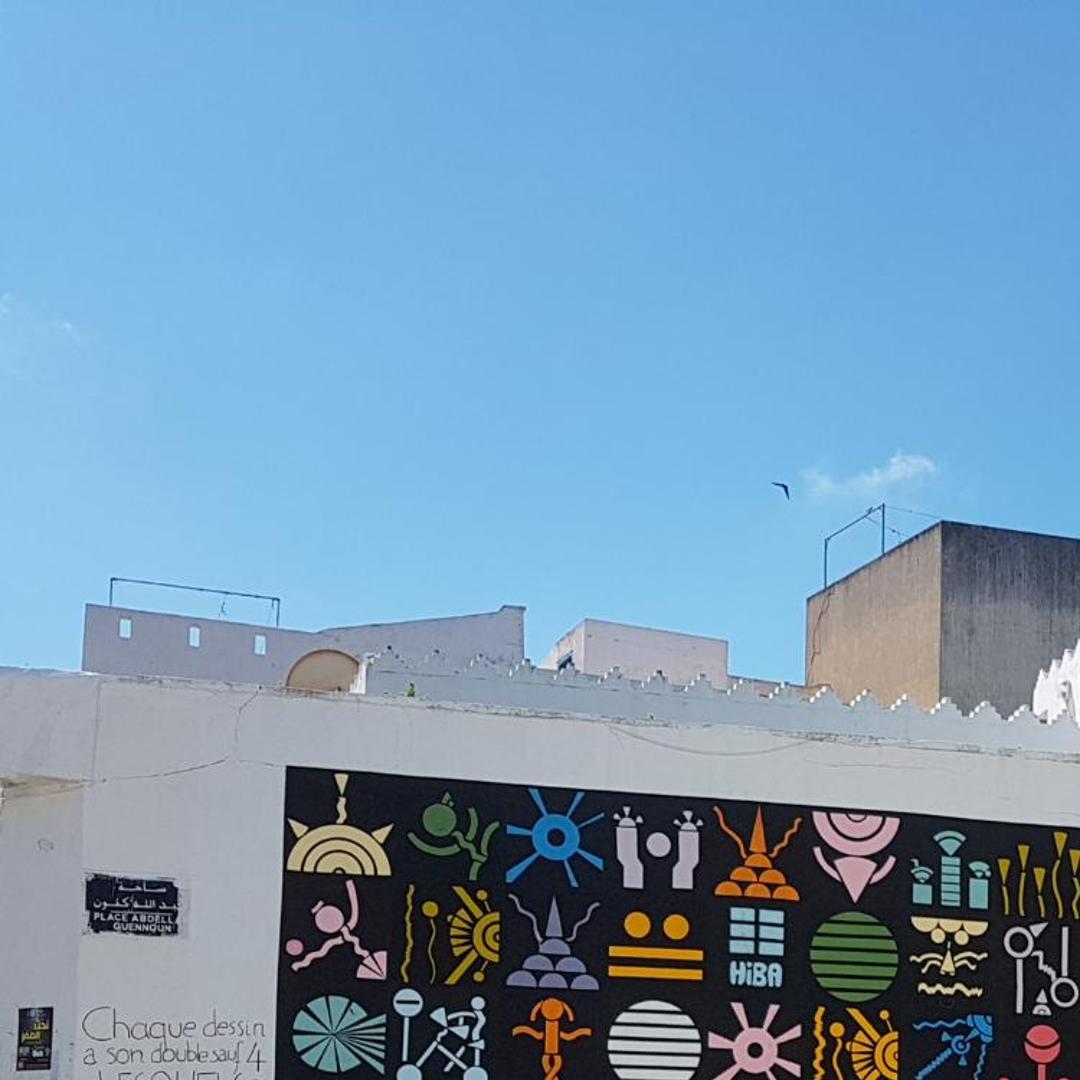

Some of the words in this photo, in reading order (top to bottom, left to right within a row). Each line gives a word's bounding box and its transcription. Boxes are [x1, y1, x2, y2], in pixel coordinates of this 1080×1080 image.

[93, 912, 129, 922] PLACE
[82, 1006, 196, 1050] Chaque
[202, 1008, 265, 1038] dessin
[83, 1047, 97, 1065] a
[107, 1047, 144, 1064] son
[151, 1041, 208, 1063] double
[209, 1040, 244, 1074] sauf
[246, 1041, 267, 1073] 4
